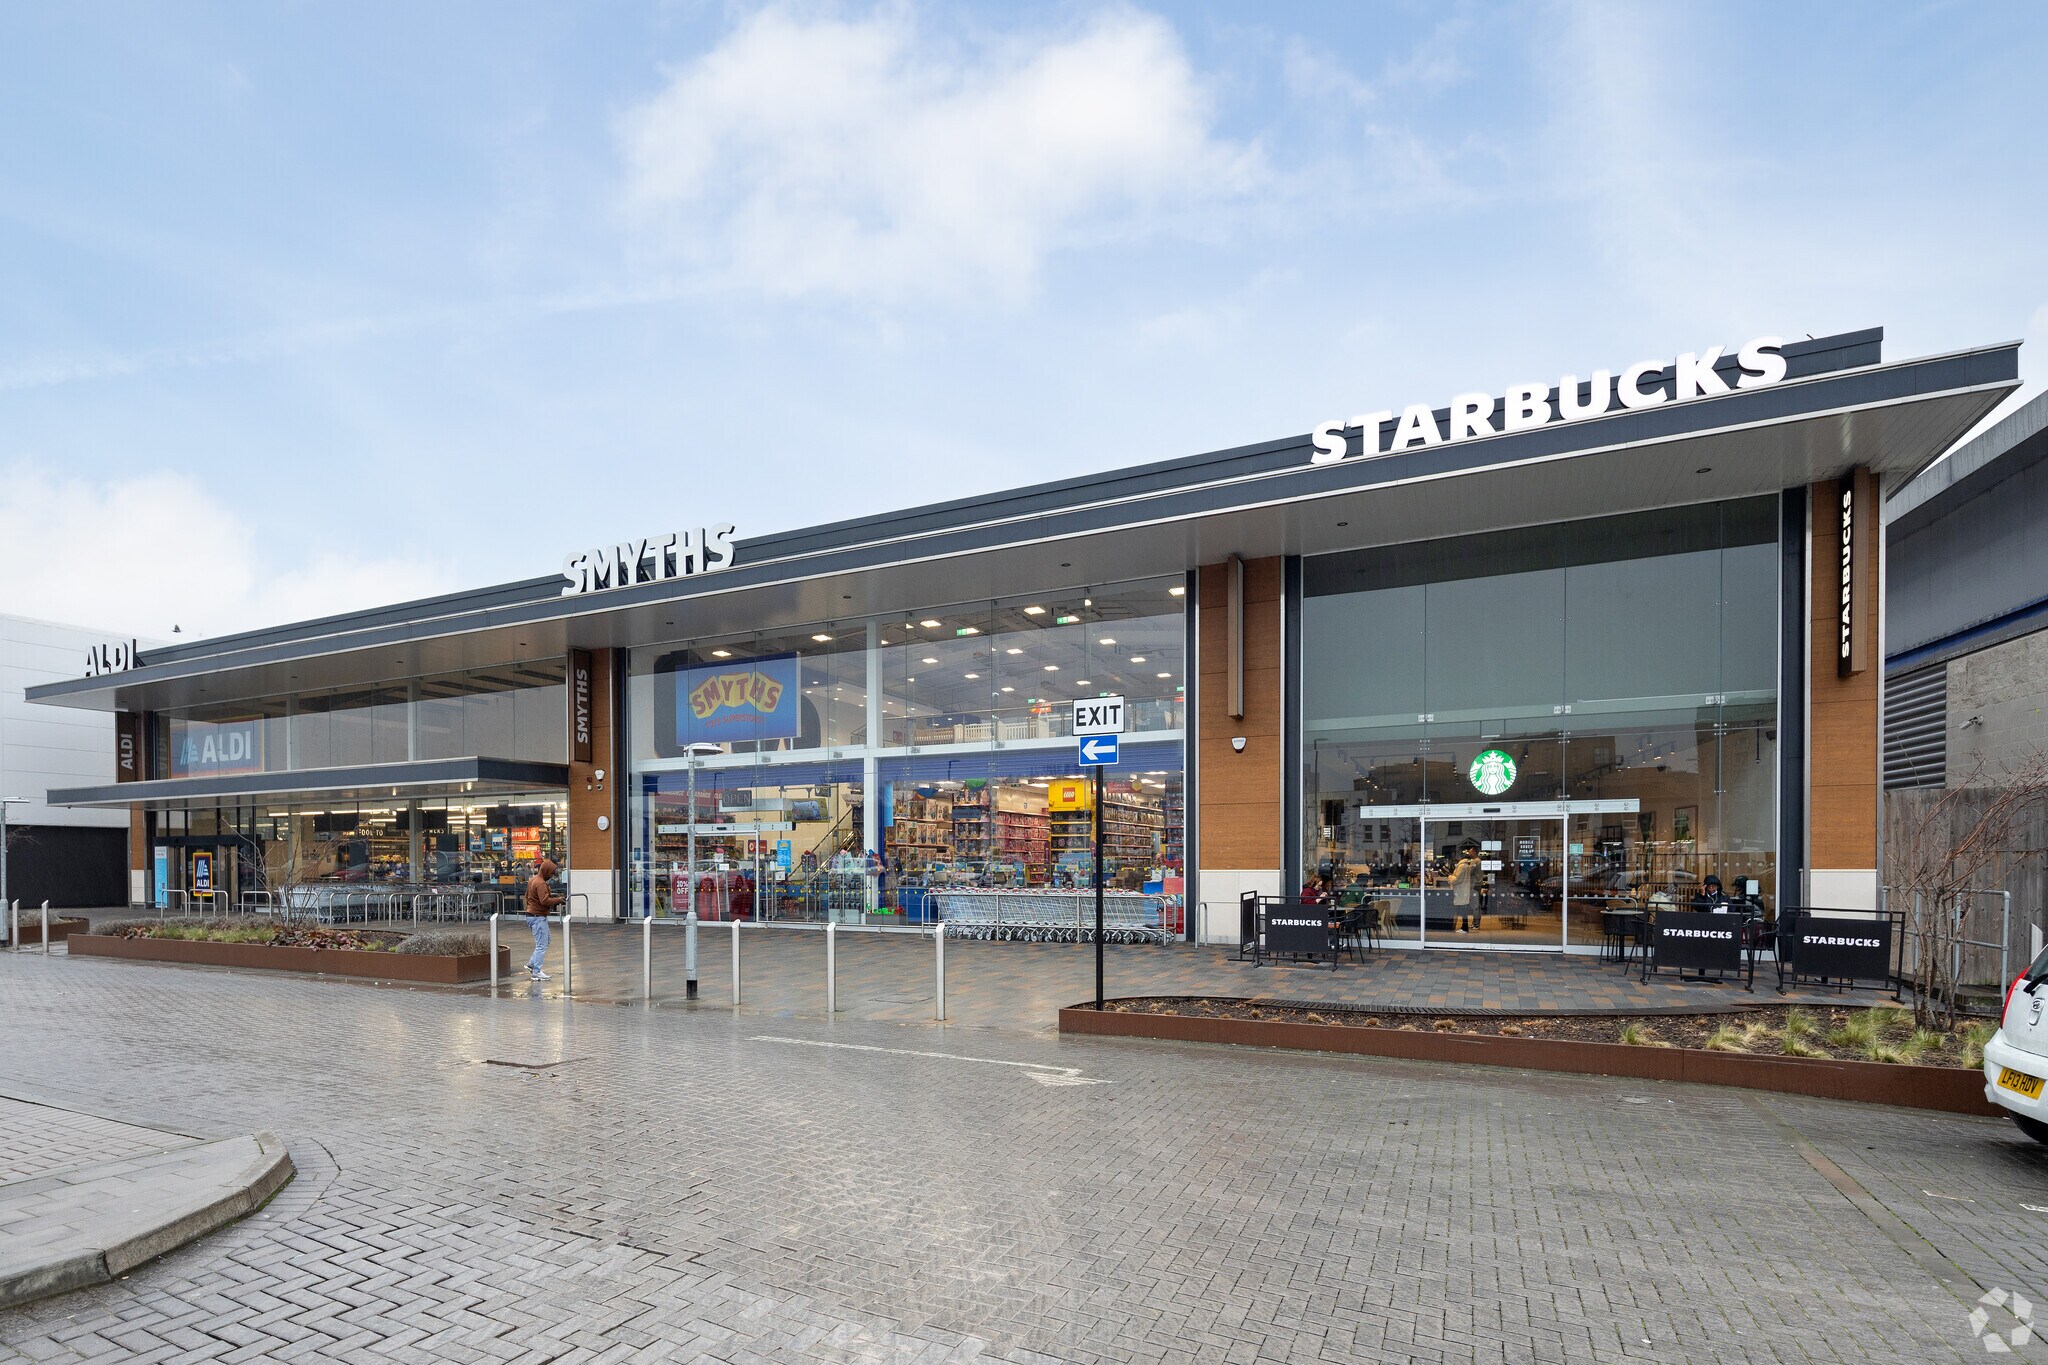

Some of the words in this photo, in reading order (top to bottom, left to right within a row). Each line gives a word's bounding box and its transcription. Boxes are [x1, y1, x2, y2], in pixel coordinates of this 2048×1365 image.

[1310, 336, 1787, 464] STARBUCKS
[561, 522, 736, 596] SMYTHS
[1842, 490, 1851, 658] STARBUCKS
[85, 638, 137, 677] ALDI
[577, 668, 588, 743] SMYTHS
[691, 677, 780, 715] SMYTHS
[1076, 705, 1121, 726] EXIT
[121, 733, 133, 770] ALDI
[202, 731, 251, 763] ALDI
[723, 794, 751, 804] OPEN
[196, 879, 210, 887] ALDI
[676, 887, 689, 895] OFF
[1663, 928, 1732, 939] STARBUCKS
[1803, 935, 1880, 947] STARBUCKS
[2002, 1070, 2021, 1087] LF13
[2019, 1075, 2038, 1093] HDV
